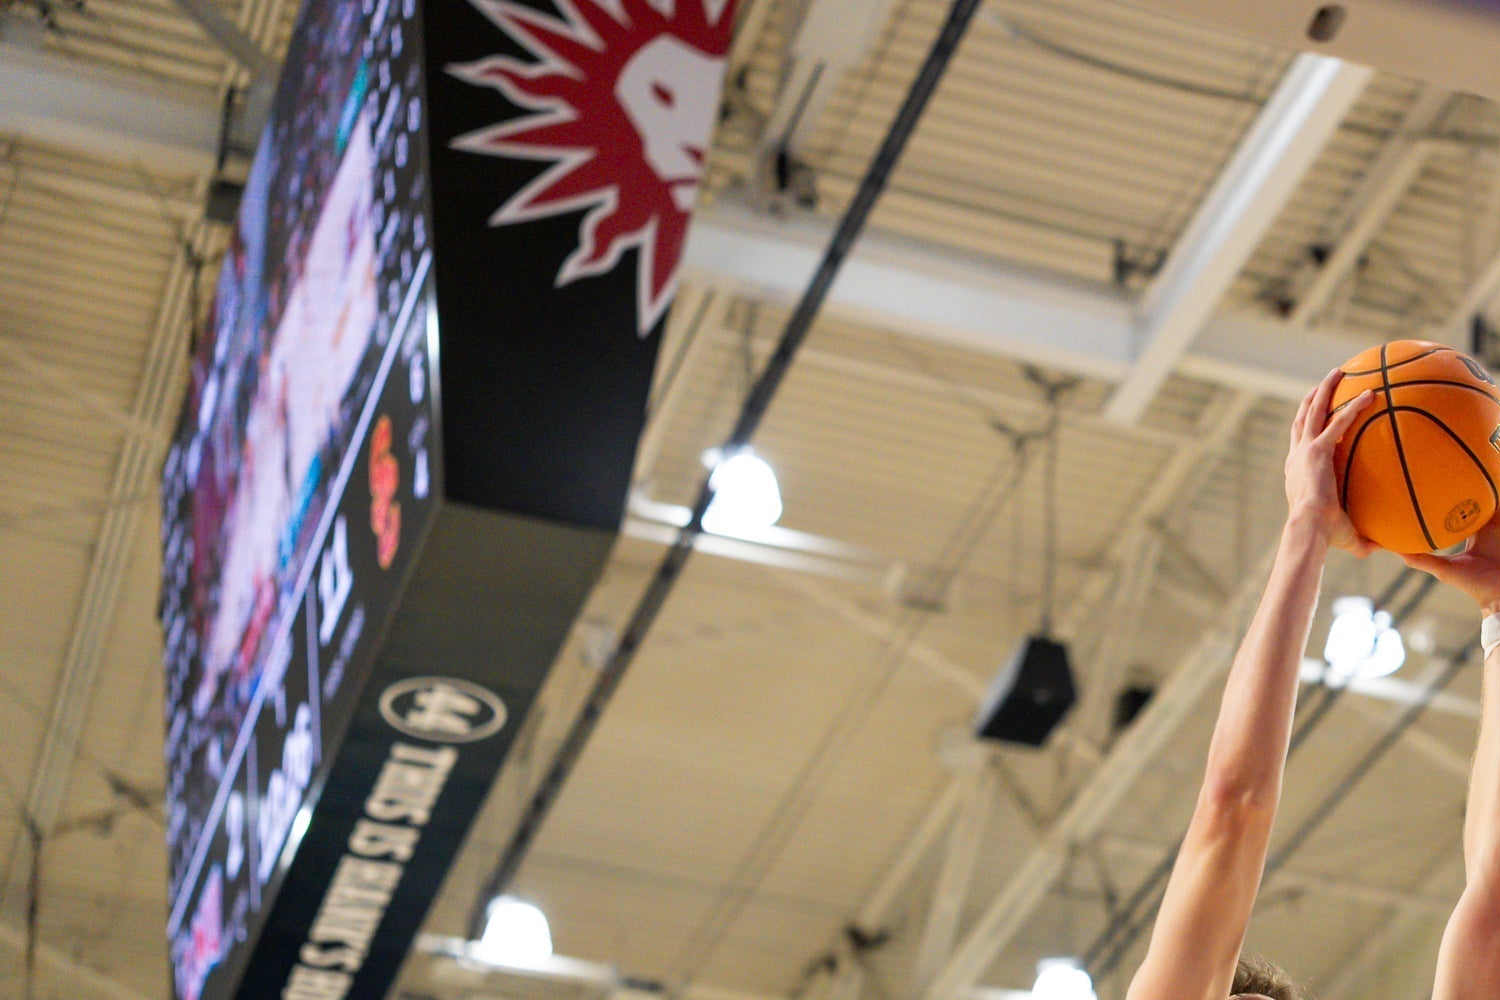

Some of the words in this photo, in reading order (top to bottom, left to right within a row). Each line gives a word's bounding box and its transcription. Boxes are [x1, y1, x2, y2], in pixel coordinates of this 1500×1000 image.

[365, 742, 459, 826] THIS
[347, 817, 421, 863] IS
[300, 854, 405, 972] HANK'S
